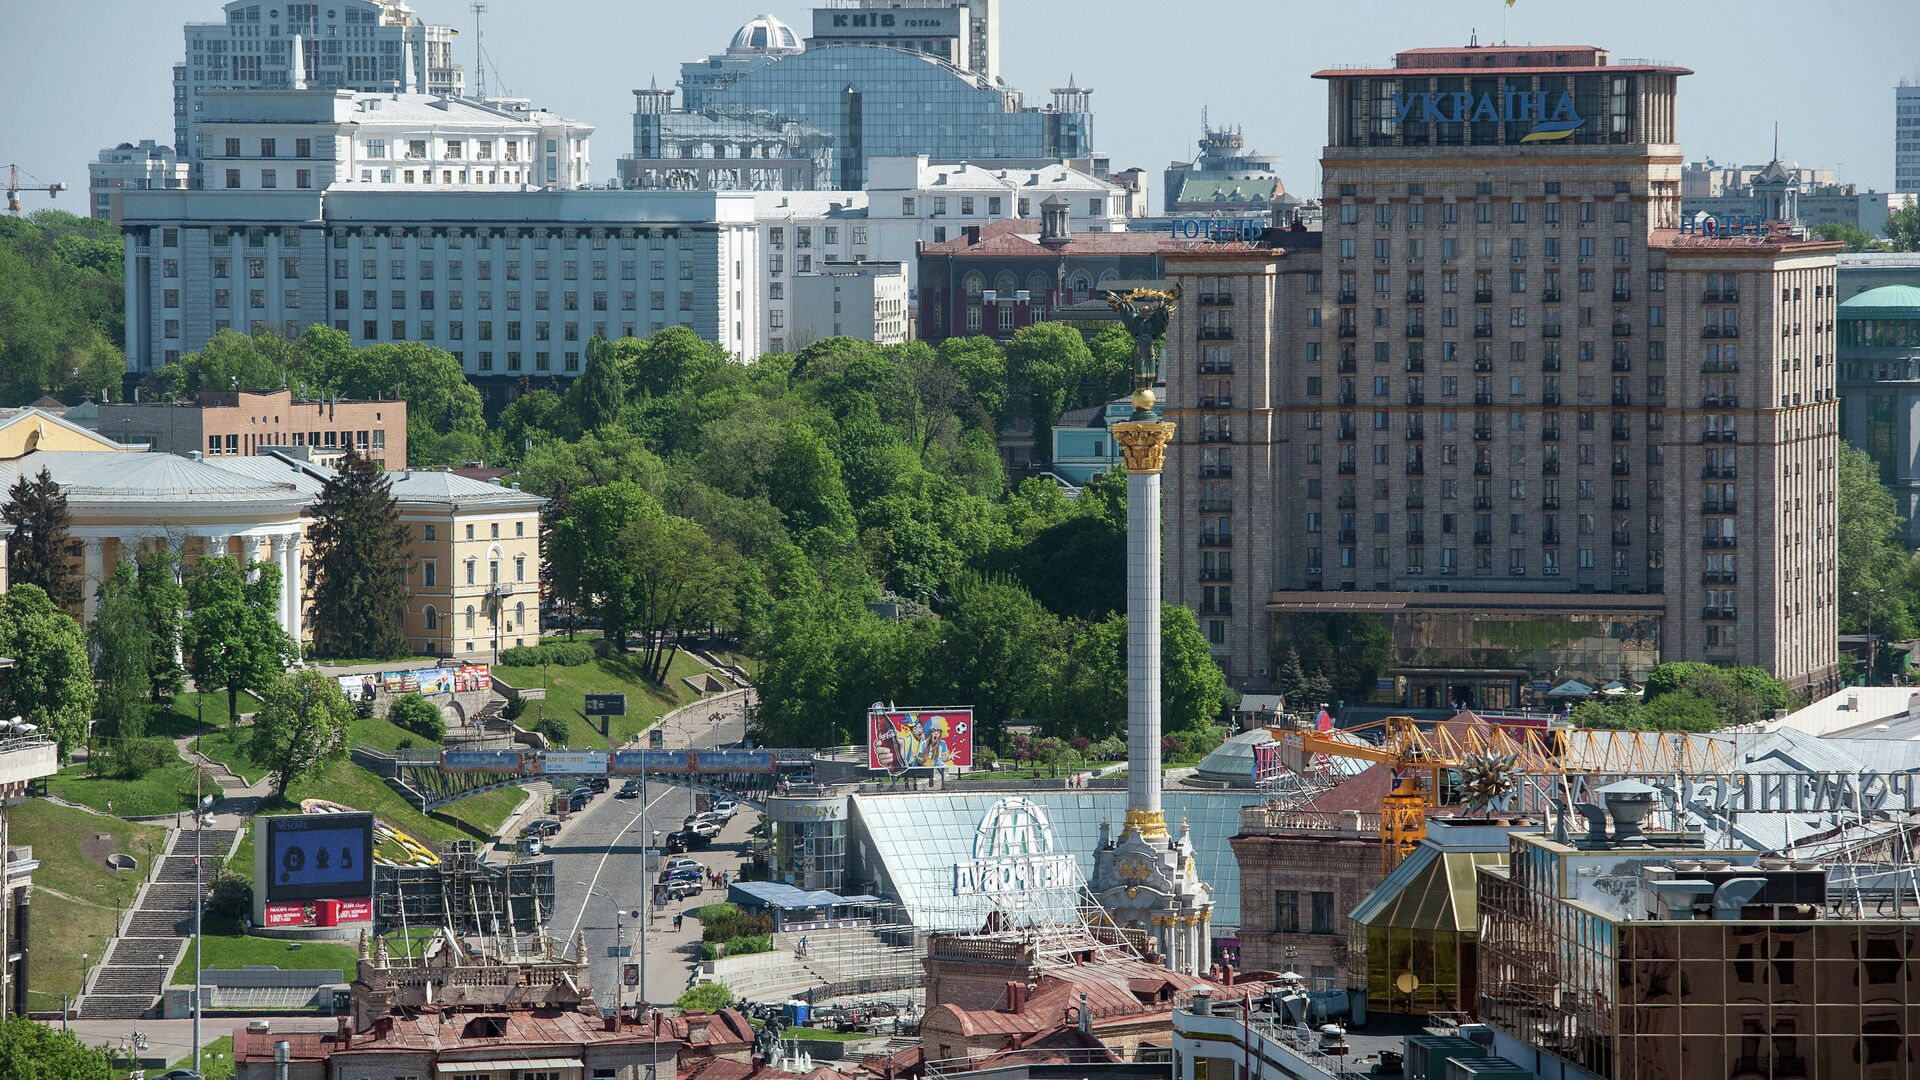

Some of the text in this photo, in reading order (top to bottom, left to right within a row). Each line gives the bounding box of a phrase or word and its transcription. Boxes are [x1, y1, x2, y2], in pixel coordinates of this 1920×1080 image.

[833, 12, 941, 27] КИЇВ ГОТЕЛЬ
[1392, 86, 1581, 123] УКРАЇНА
[1170, 219, 1262, 241] ГОТЕЛЬ
[1680, 212, 1764, 236] HOTEL
